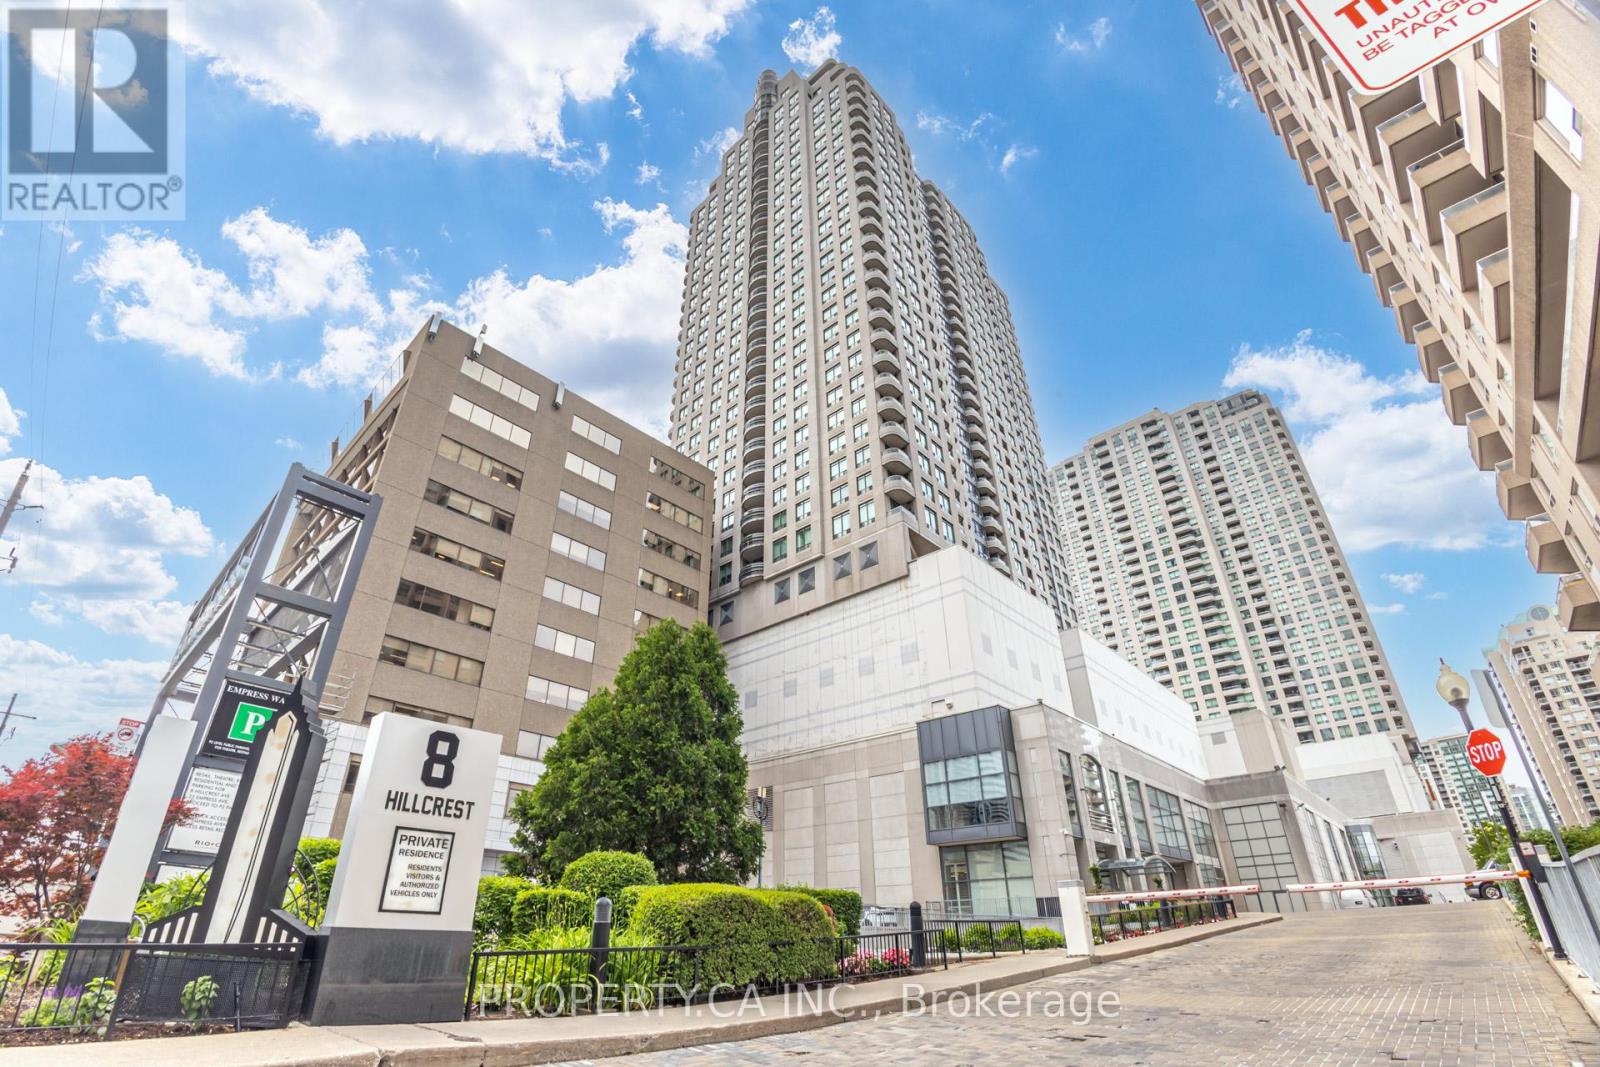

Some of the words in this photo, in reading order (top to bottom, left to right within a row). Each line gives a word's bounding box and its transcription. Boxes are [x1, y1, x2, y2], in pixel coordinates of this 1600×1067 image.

[1357, 0, 1440, 47] UNAUT
[1363, 38, 1395, 61] BE
[1395, 0, 1470, 39] TAGG
[1434, 15, 1458, 39] AT
[1467, 0, 1498, 16] O
[227, 685, 269, 701] EMPRESS
[240, 711, 266, 735] P
[420, 730, 460, 789] 8
[1470, 741, 1502, 764] STOP
[384, 790, 475, 820] HILLCREST
[398, 834, 450, 849] PRIVATE
[398, 849, 445, 860] RESIDENCE
[406, 872, 434, 880] VISITORS
[408, 864, 442, 872] RESIDENTS
[422, 891, 438, 899] ONLY
